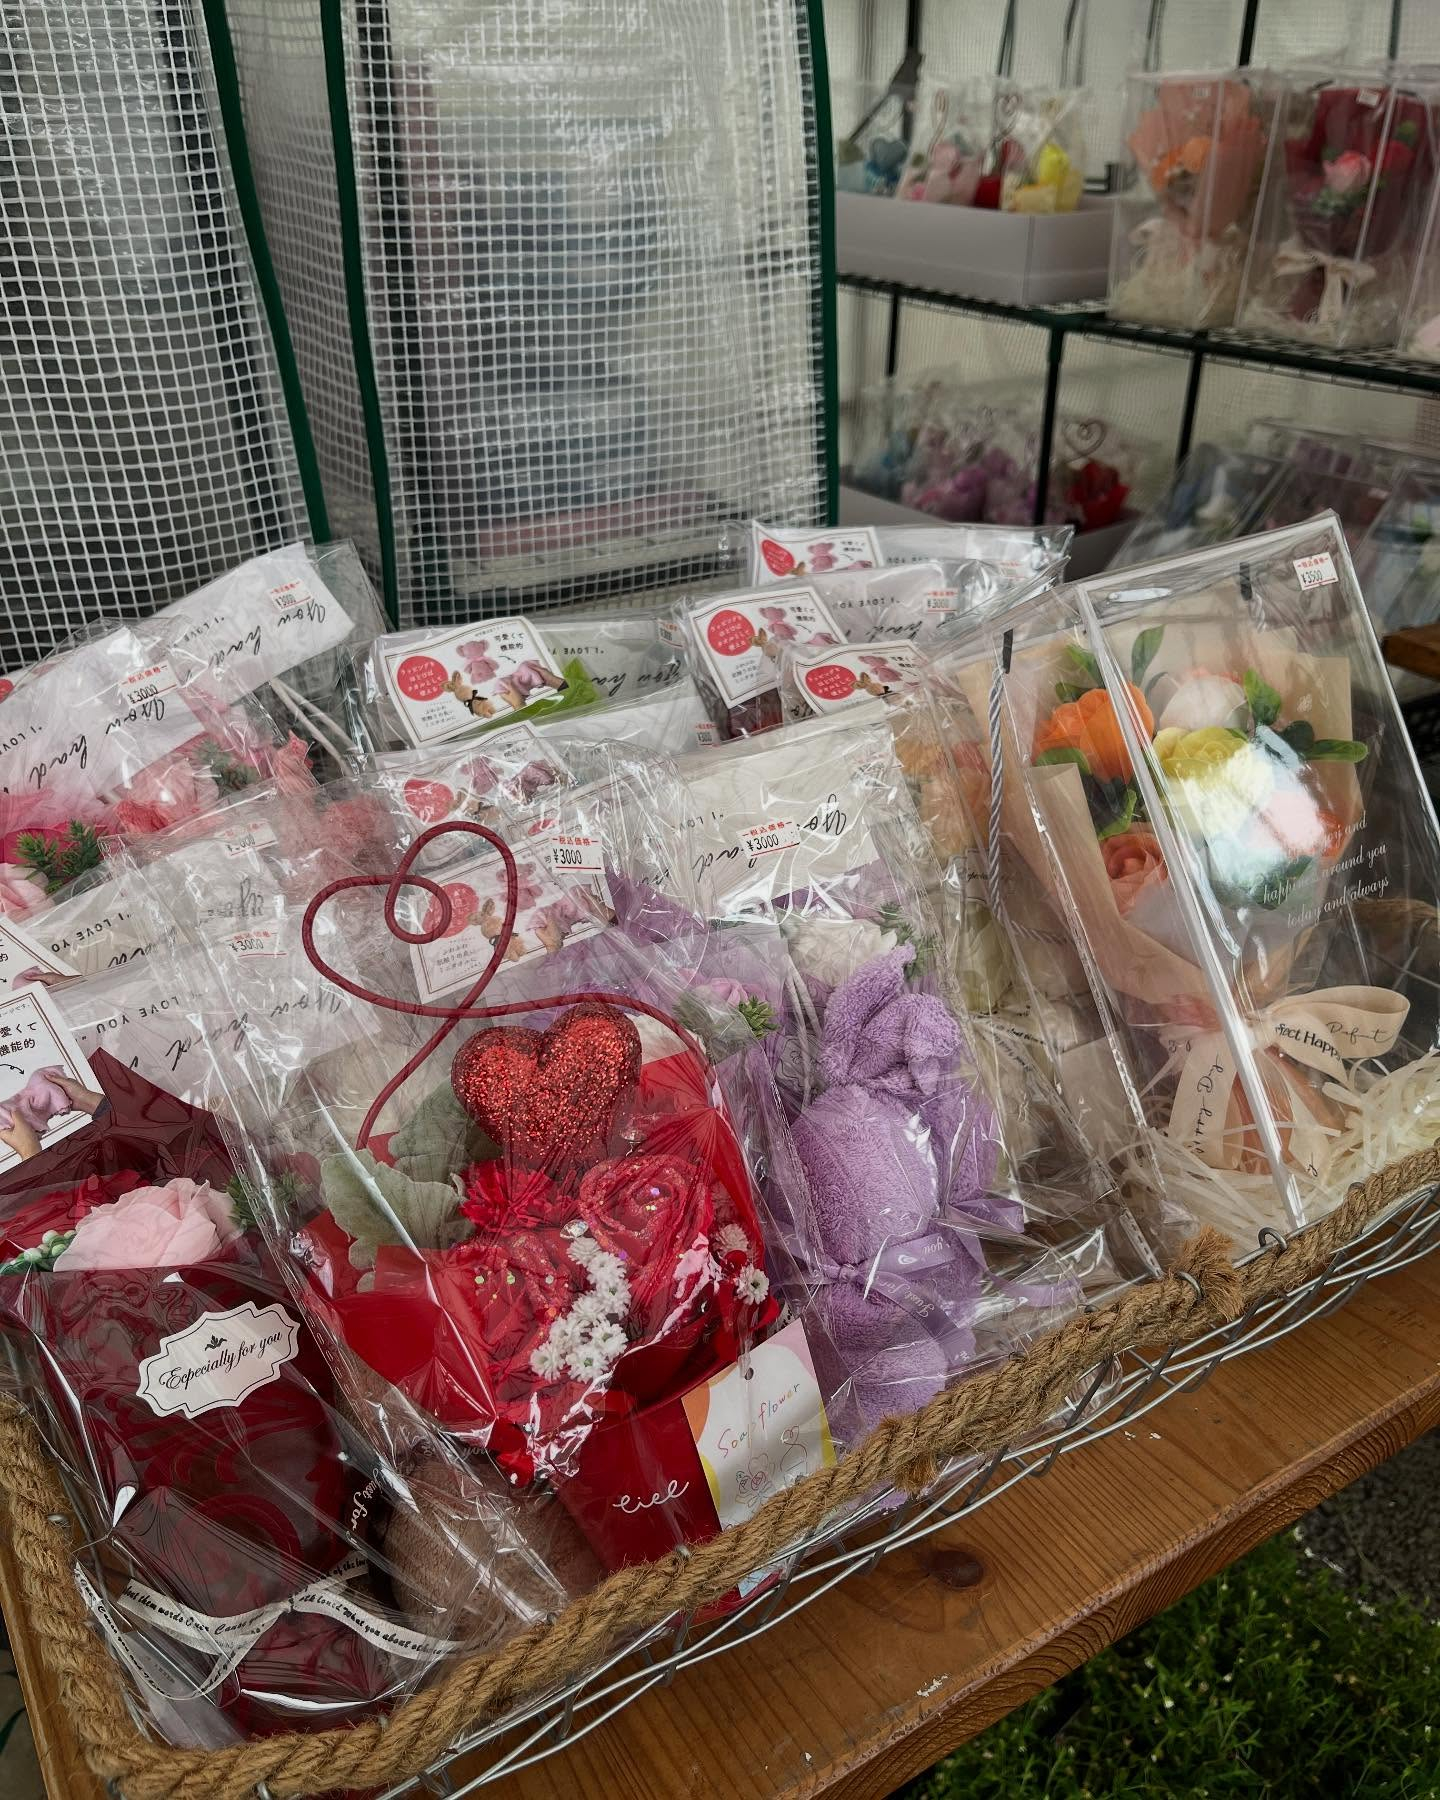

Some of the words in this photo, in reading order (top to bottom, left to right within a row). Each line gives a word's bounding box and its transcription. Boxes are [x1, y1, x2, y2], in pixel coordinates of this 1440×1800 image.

[127, 684, 159, 704] ¥3000
[105, 698, 165, 735] You
[28, 735, 87, 789] had
[559, 835, 591, 846] 税込価格
[747, 833, 779, 852] ¥3000
[552, 848, 582, 865] ¥3000
[1366, 843, 1387, 869] you
[1323, 885, 1347, 913] and
[1350, 876, 1389, 898] always
[76, 918, 112, 941] LOVE
[139, 996, 179, 1018] LOVE
[96, 1014, 130, 1034] YOU
[903, 1290, 935, 1318] Just
[233, 1340, 257, 1369] for
[258, 1331, 283, 1359] you
[758, 1384, 800, 1431] flower
[138, 1594, 158, 1613] them
[364, 1624, 382, 1639] you
[381, 1632, 412, 1650] about
